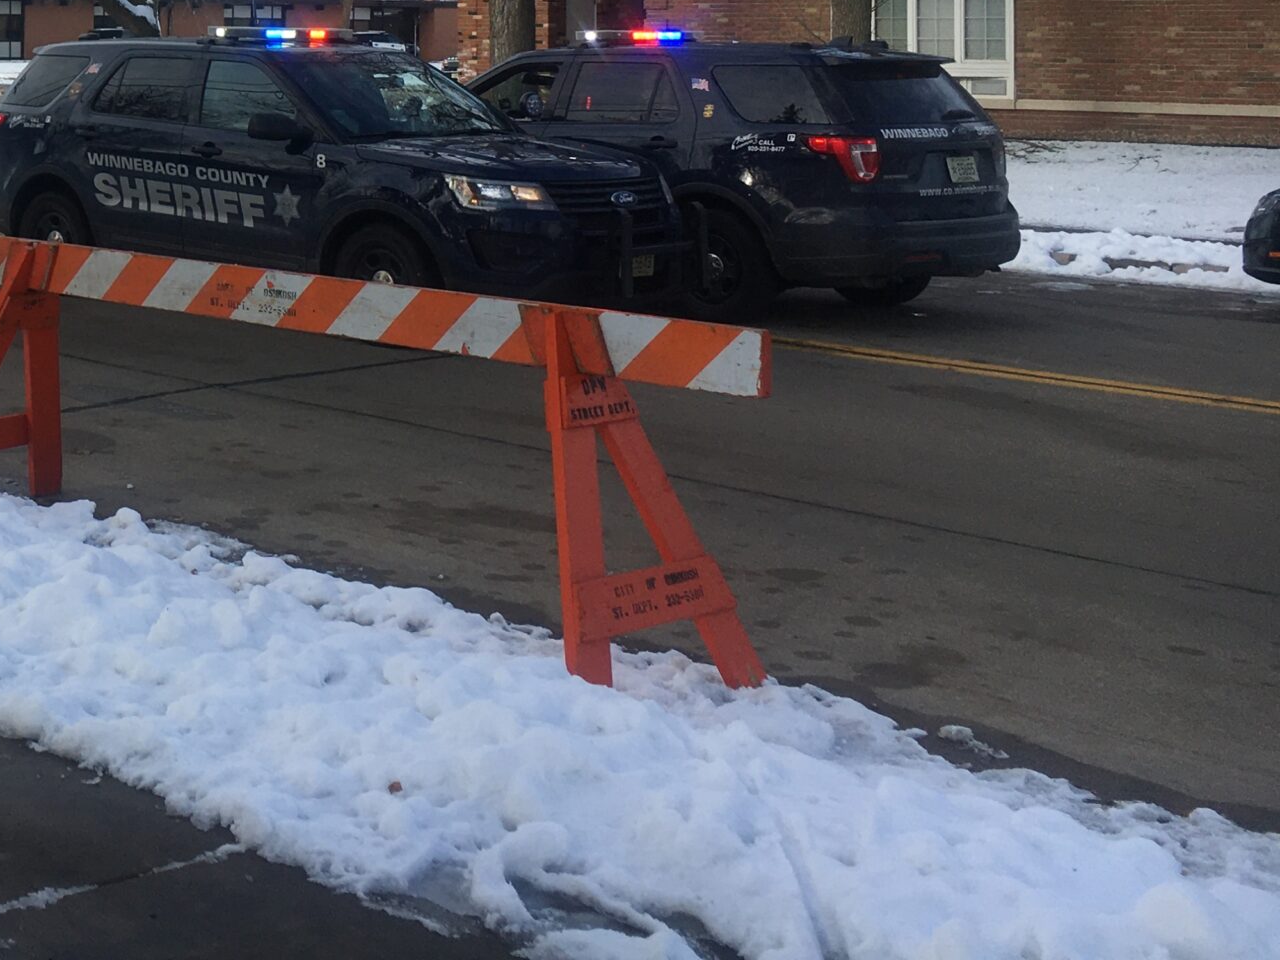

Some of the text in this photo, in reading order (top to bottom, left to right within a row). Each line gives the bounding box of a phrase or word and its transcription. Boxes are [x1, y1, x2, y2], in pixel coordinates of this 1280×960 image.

[880, 127, 949, 139] WINNEBAGO
[316, 153, 326, 169] 8
[87, 151, 270, 189] WINNEBAGO COUNTY
[93, 172, 265, 228] SHERIFF
[619, 194, 634, 203] Ford
[570, 405, 605, 420] STREET
[614, 584, 634, 597] CITY
